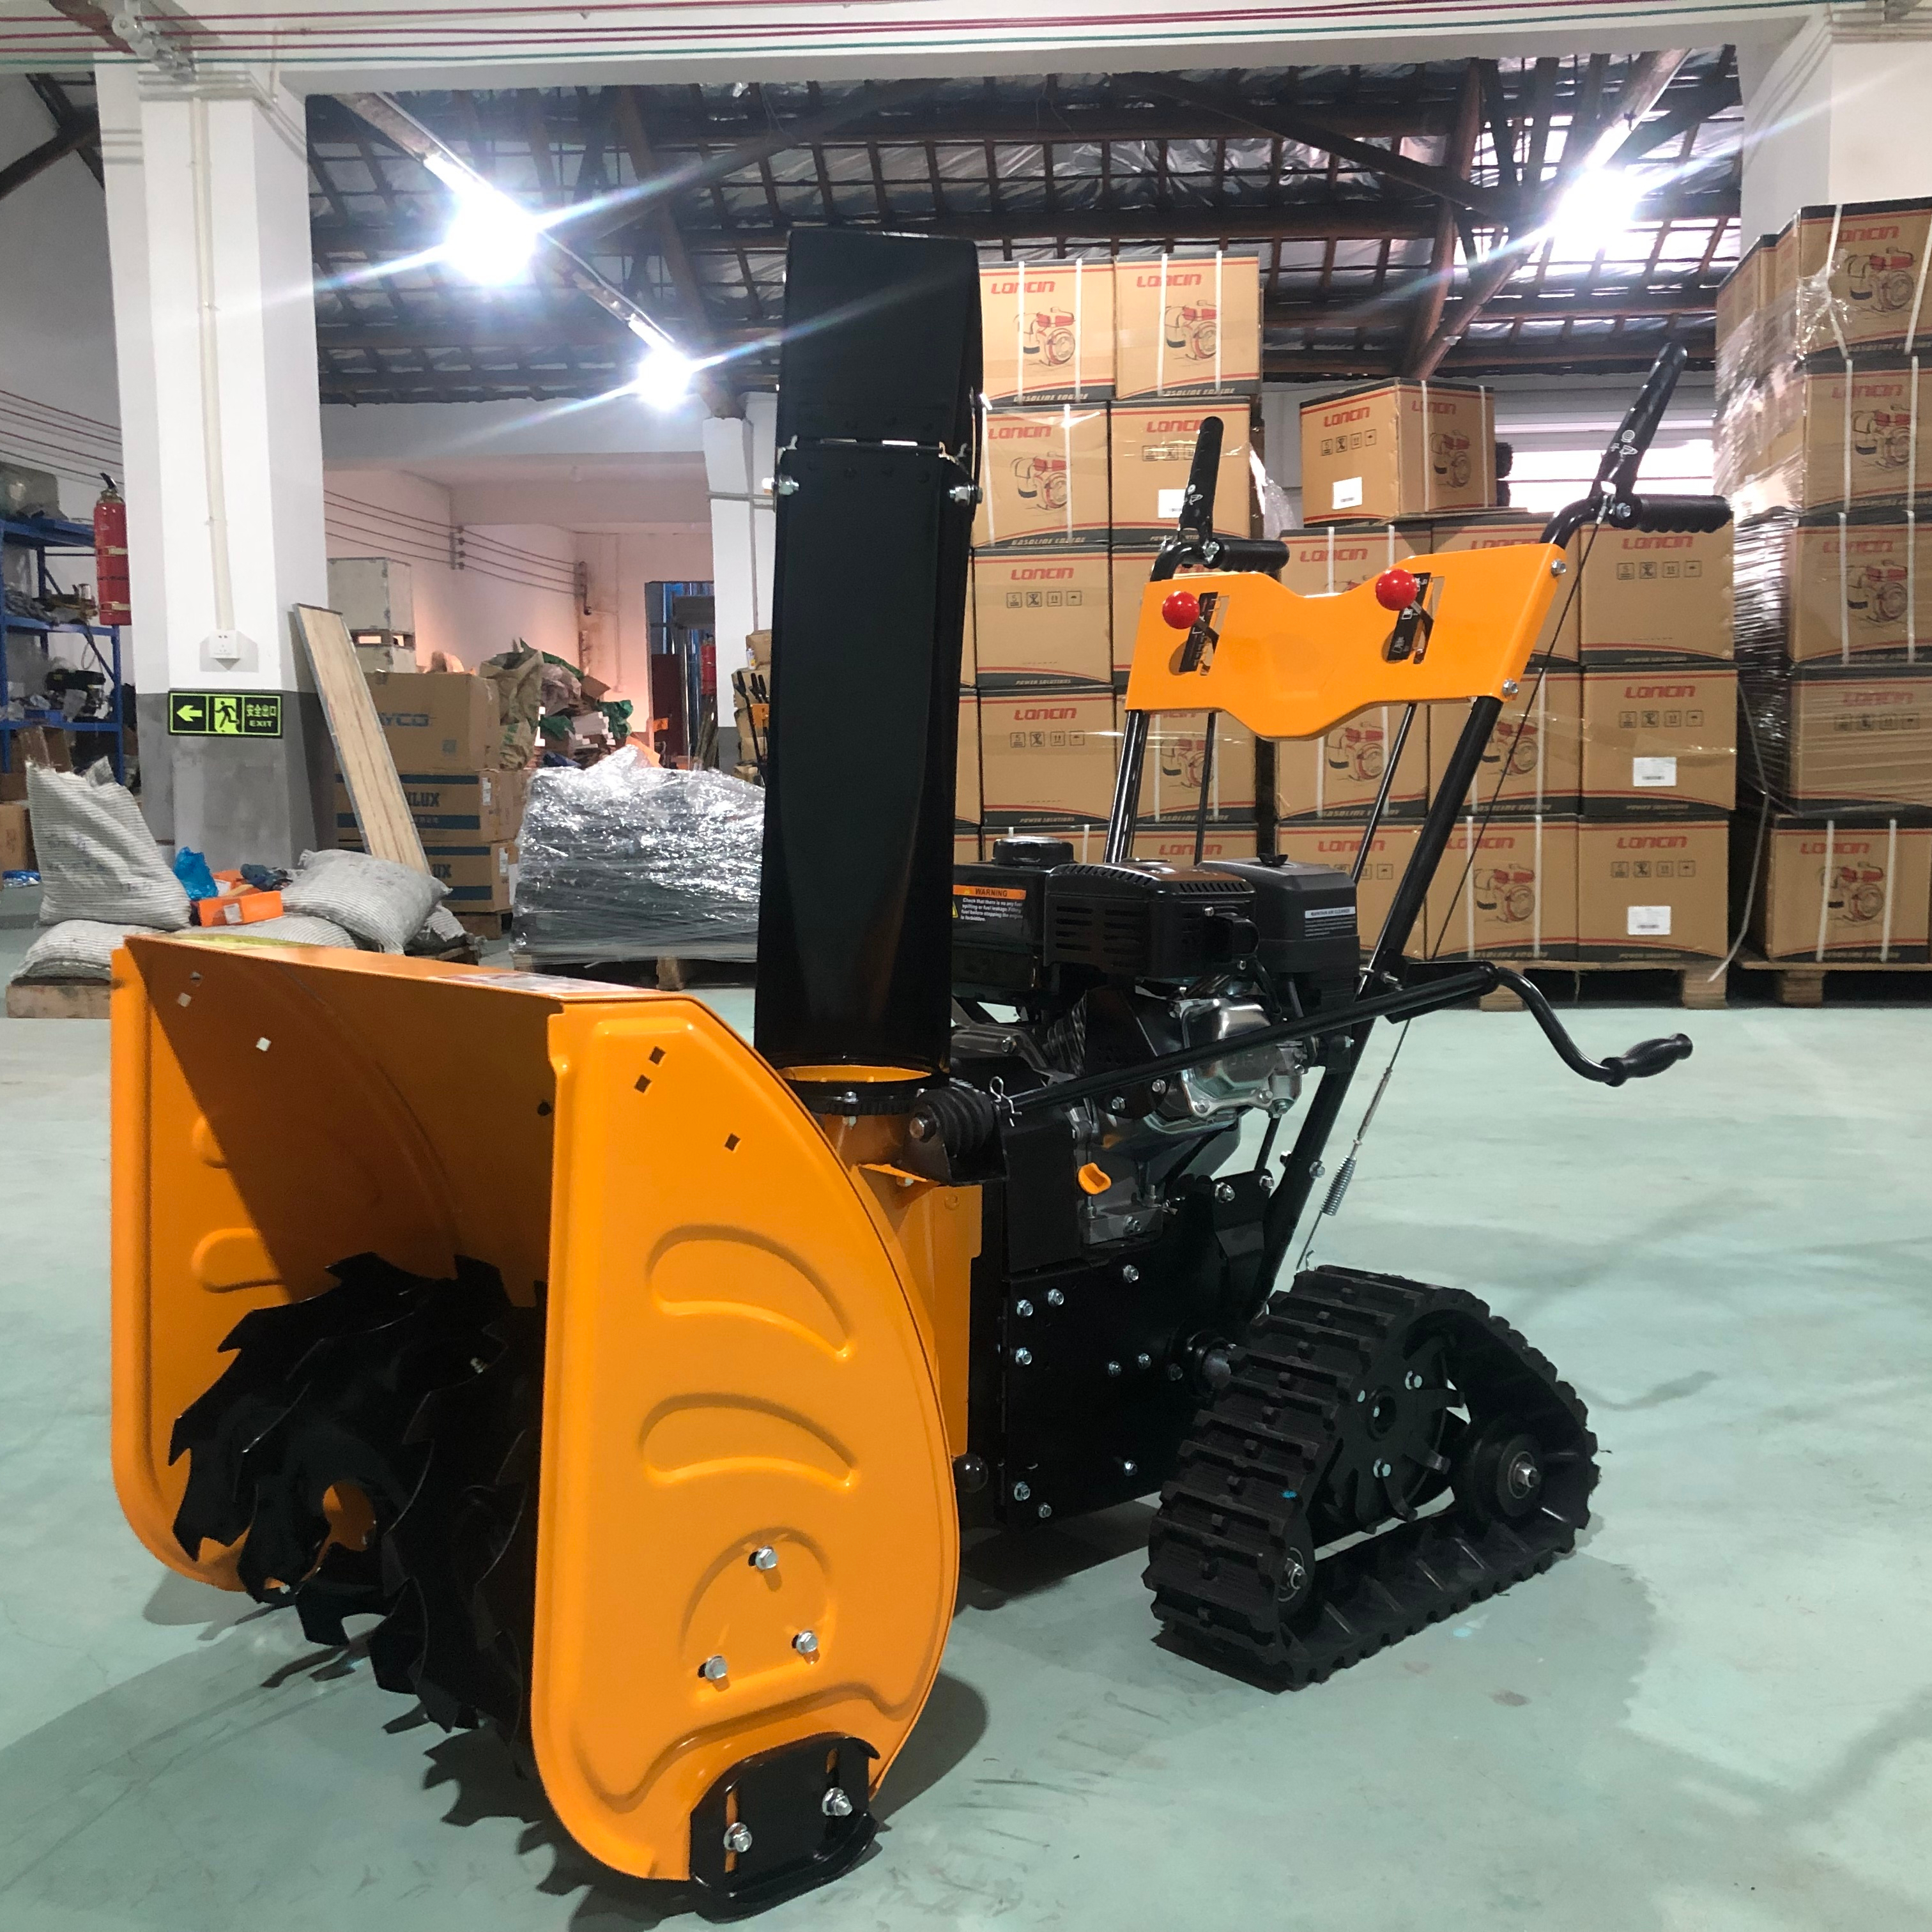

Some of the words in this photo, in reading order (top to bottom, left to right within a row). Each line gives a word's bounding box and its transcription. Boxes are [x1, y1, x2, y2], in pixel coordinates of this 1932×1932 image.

[1828, 226, 1899, 243] ONCIN
[1323, 406, 1370, 427] LONCIN
[988, 425, 1052, 440] LONCIN
[1146, 420, 1204, 433] LONCI
[1621, 536, 1693, 549] LONCIN
[1011, 567, 1074, 581] LONCIN
[1624, 686, 1695, 698] LONCIN
[246, 703, 277, 717] 安全出口
[1014, 708, 1077, 721] LONCIN
[1318, 839, 1385, 852] LONN
[1616, 836, 1687, 849] LONCIN
[1159, 844, 1222, 855] LONIN
[975, 888, 1008, 897] WARNING
